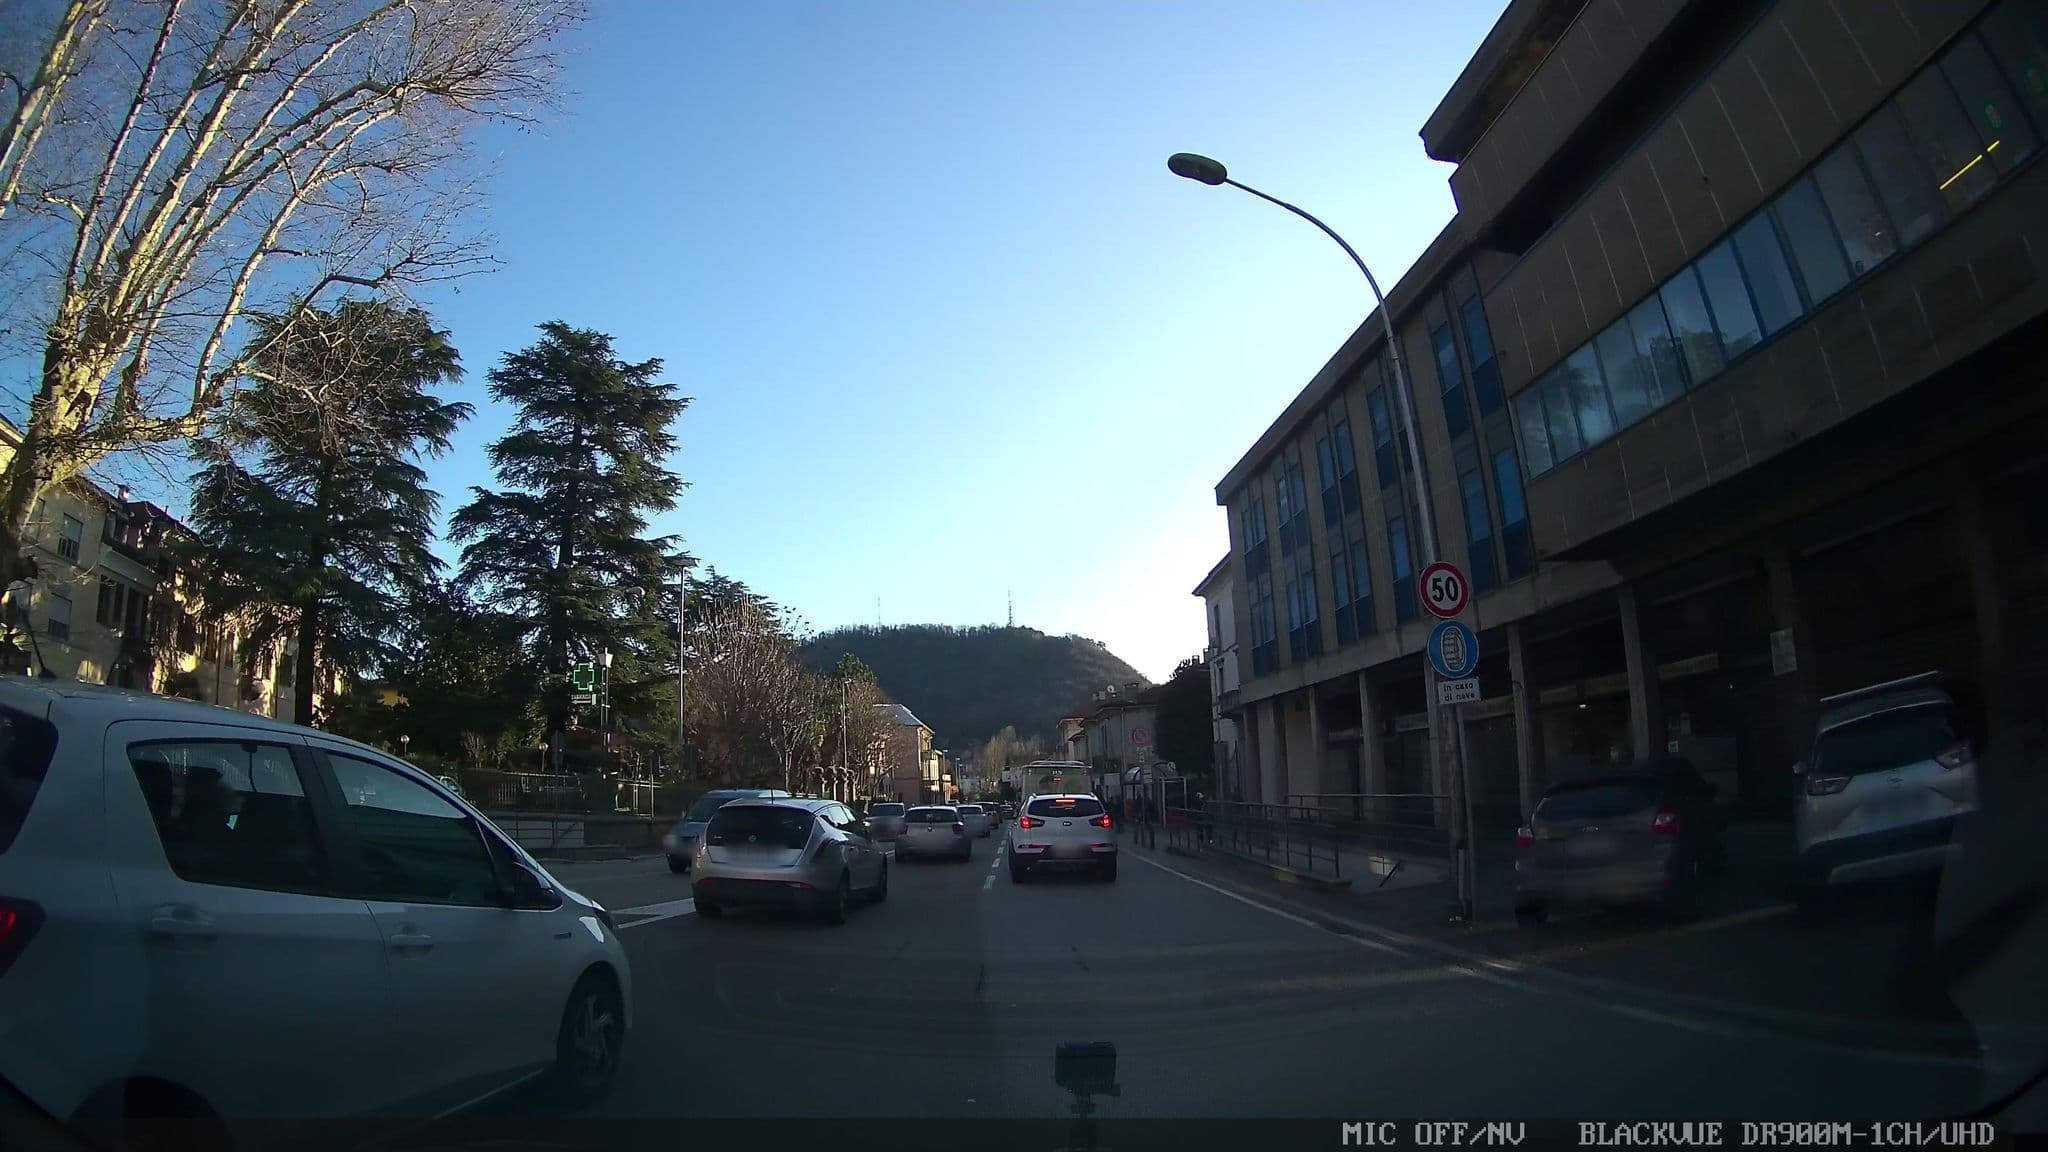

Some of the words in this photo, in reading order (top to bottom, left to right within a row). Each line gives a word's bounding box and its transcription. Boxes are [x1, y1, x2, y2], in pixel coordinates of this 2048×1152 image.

[1432, 577, 1459, 602] 50
[1455, 682, 1474, 690] caso
[1444, 692, 1453, 702] di
